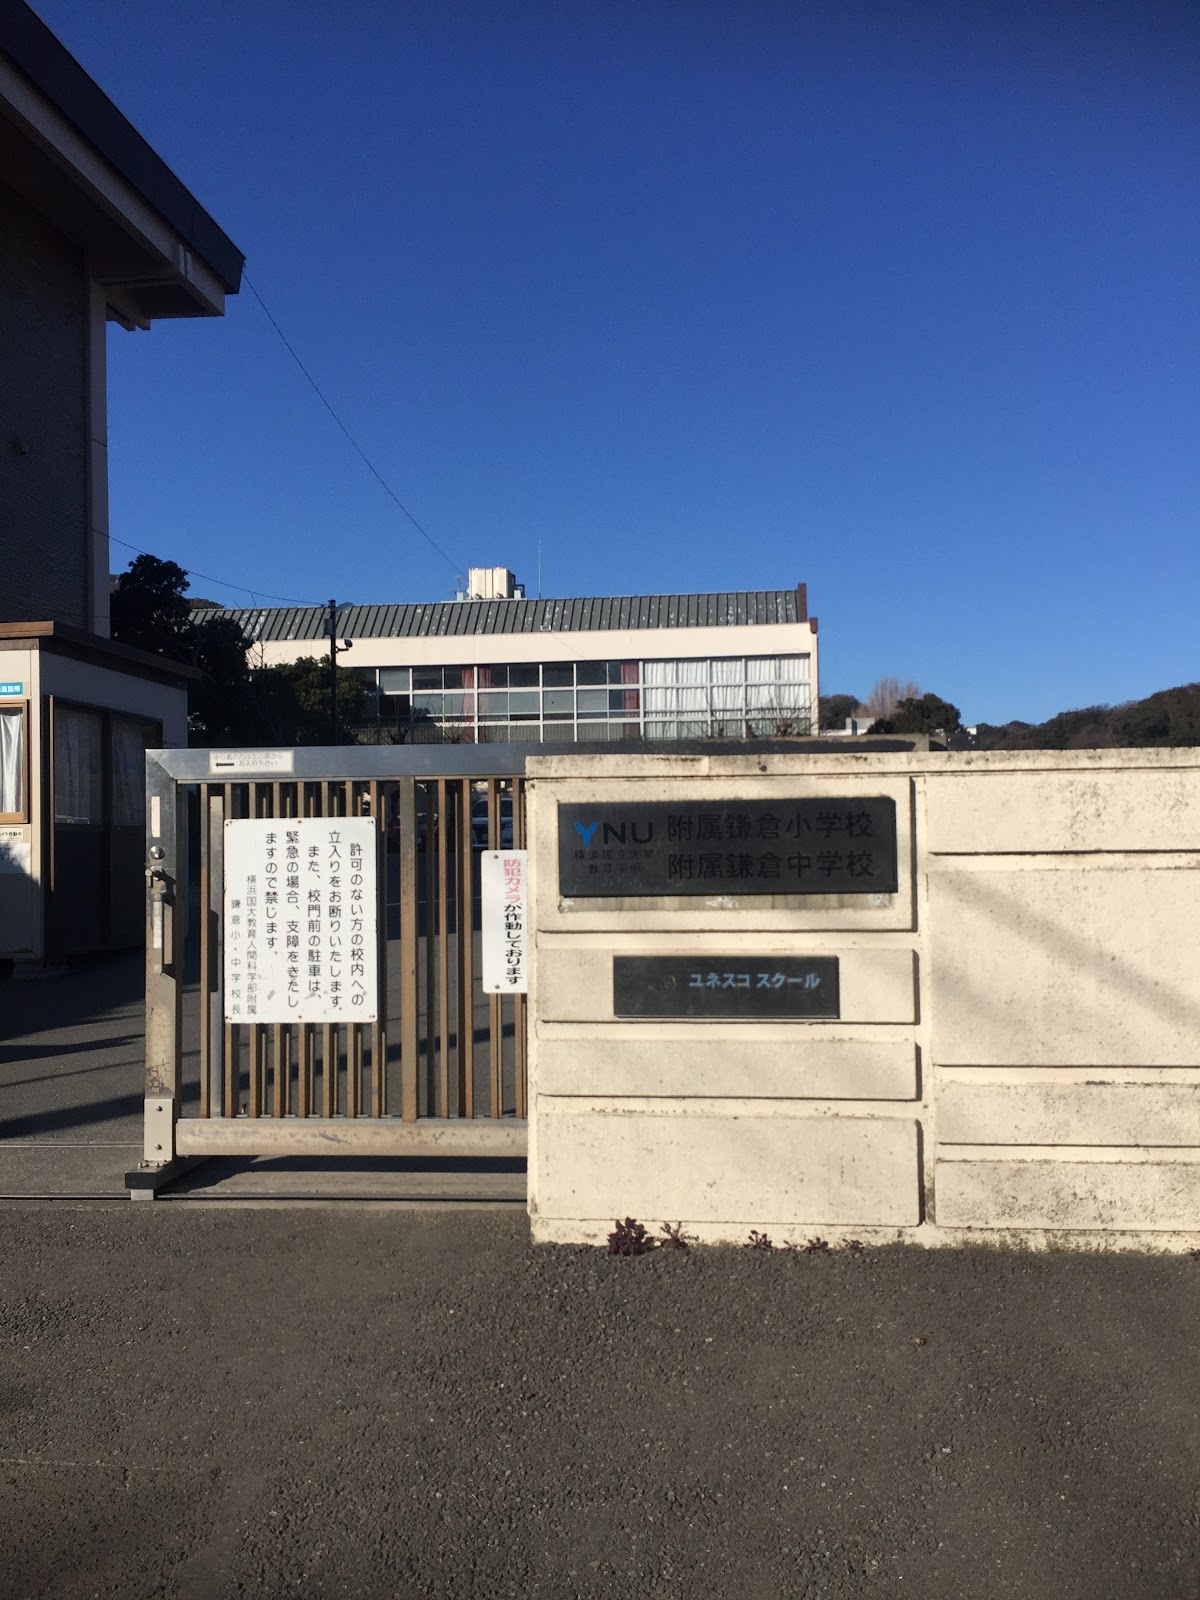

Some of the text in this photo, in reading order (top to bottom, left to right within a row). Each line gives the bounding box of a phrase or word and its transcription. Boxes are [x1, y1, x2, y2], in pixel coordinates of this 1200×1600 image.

[573, 821, 653, 846] YNU
[667, 811, 873, 841] 附属鎌倉小学校
[668, 850, 874, 880] 附属鎌倉中学校
[246, 874, 257, 1015] 横浜国大教育人間科学部附属
[265, 832, 278, 955] ますので禁じます。
[286, 831, 300, 1008] 緊急の場合、支障をきたし
[307, 845, 321, 999] また、校門前の駐車は、
[328, 830, 343, 1011] 立入りをお断りいたします。
[350, 843, 364, 1006] 許可のない方の校内への
[503, 859, 522, 985] 防犯カメラが作動しております
[230, 899, 241, 1015] 鎌倉小・中学校長
[688, 973, 820, 988] ユネスコ スクール
